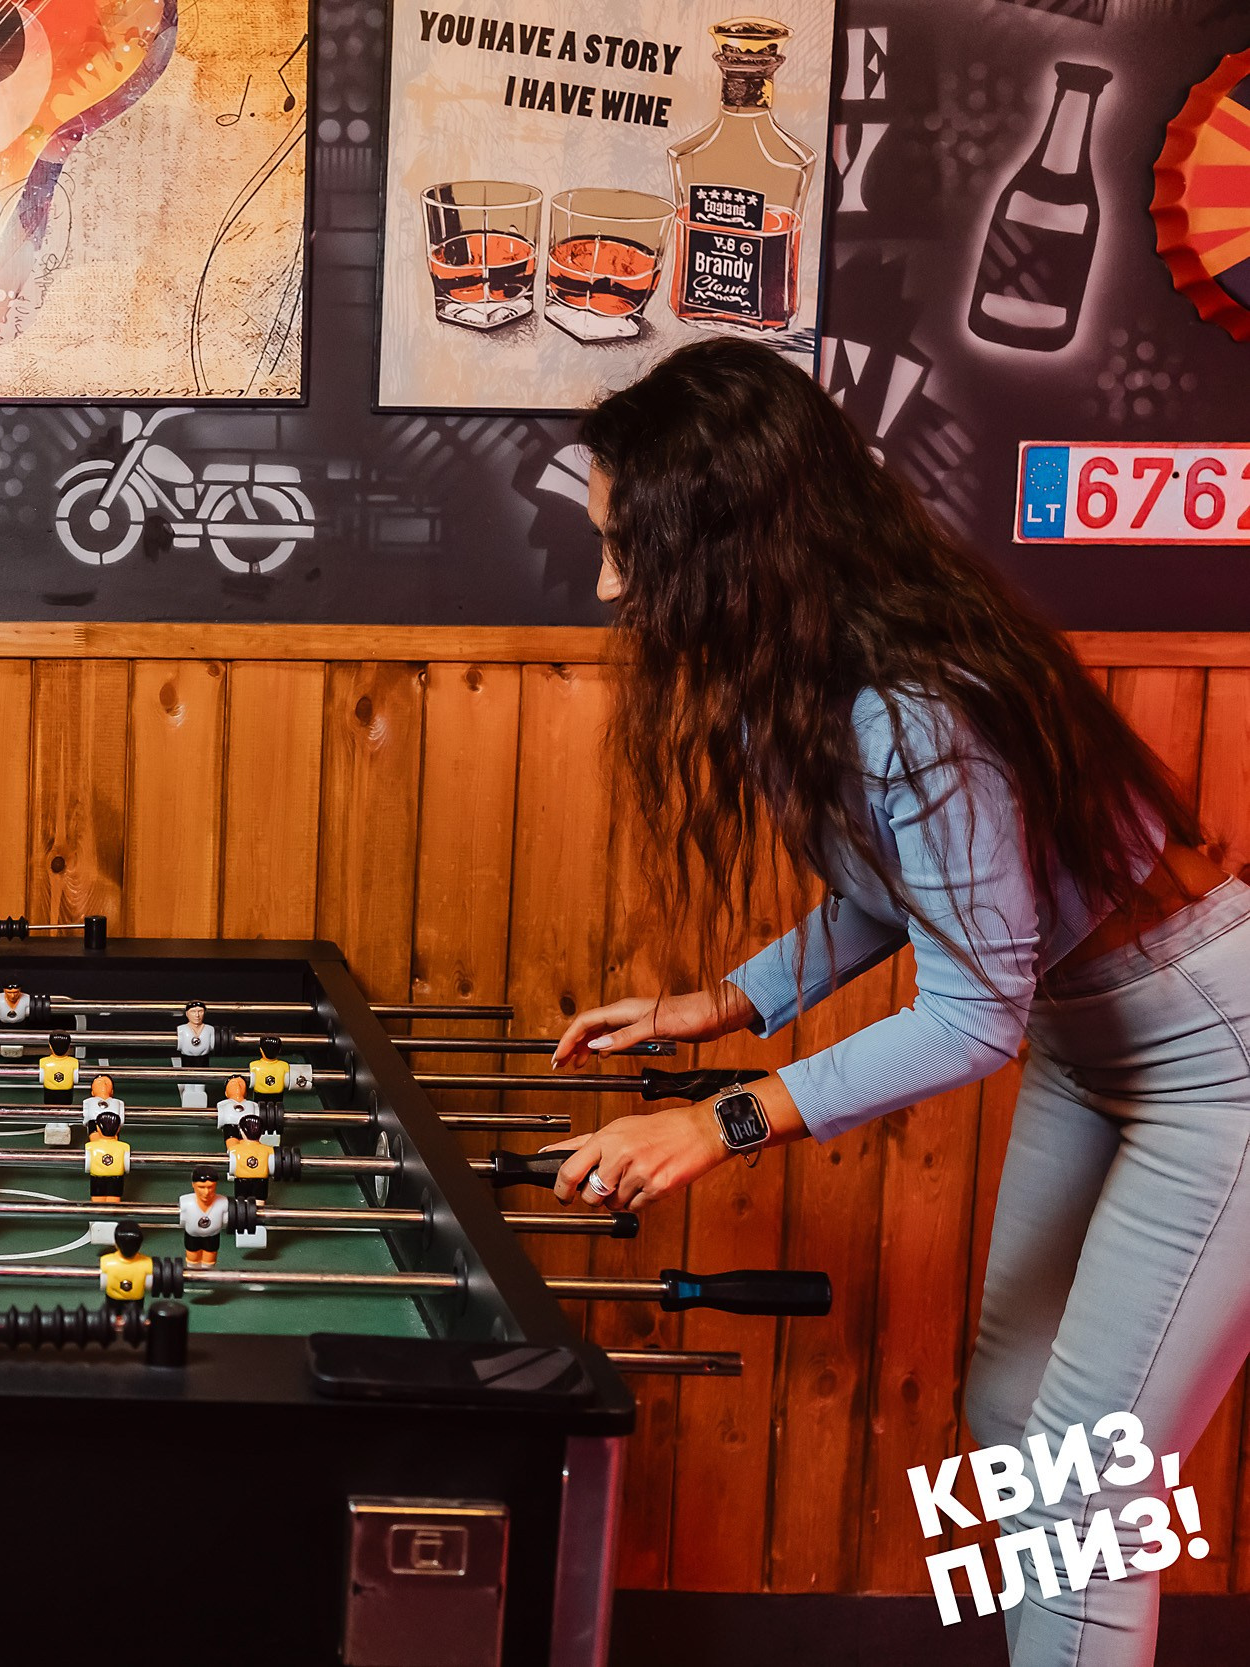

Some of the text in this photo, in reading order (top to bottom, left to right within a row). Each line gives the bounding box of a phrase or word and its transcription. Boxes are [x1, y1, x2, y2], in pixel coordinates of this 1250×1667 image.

[420, 10, 682, 75] YOU HAVE A STORY
[504, 75, 672, 128] I HAVE WINE
[704, 199, 746, 218] England
[695, 251, 753, 283] Brandy
[1027, 504, 1061, 523] LT
